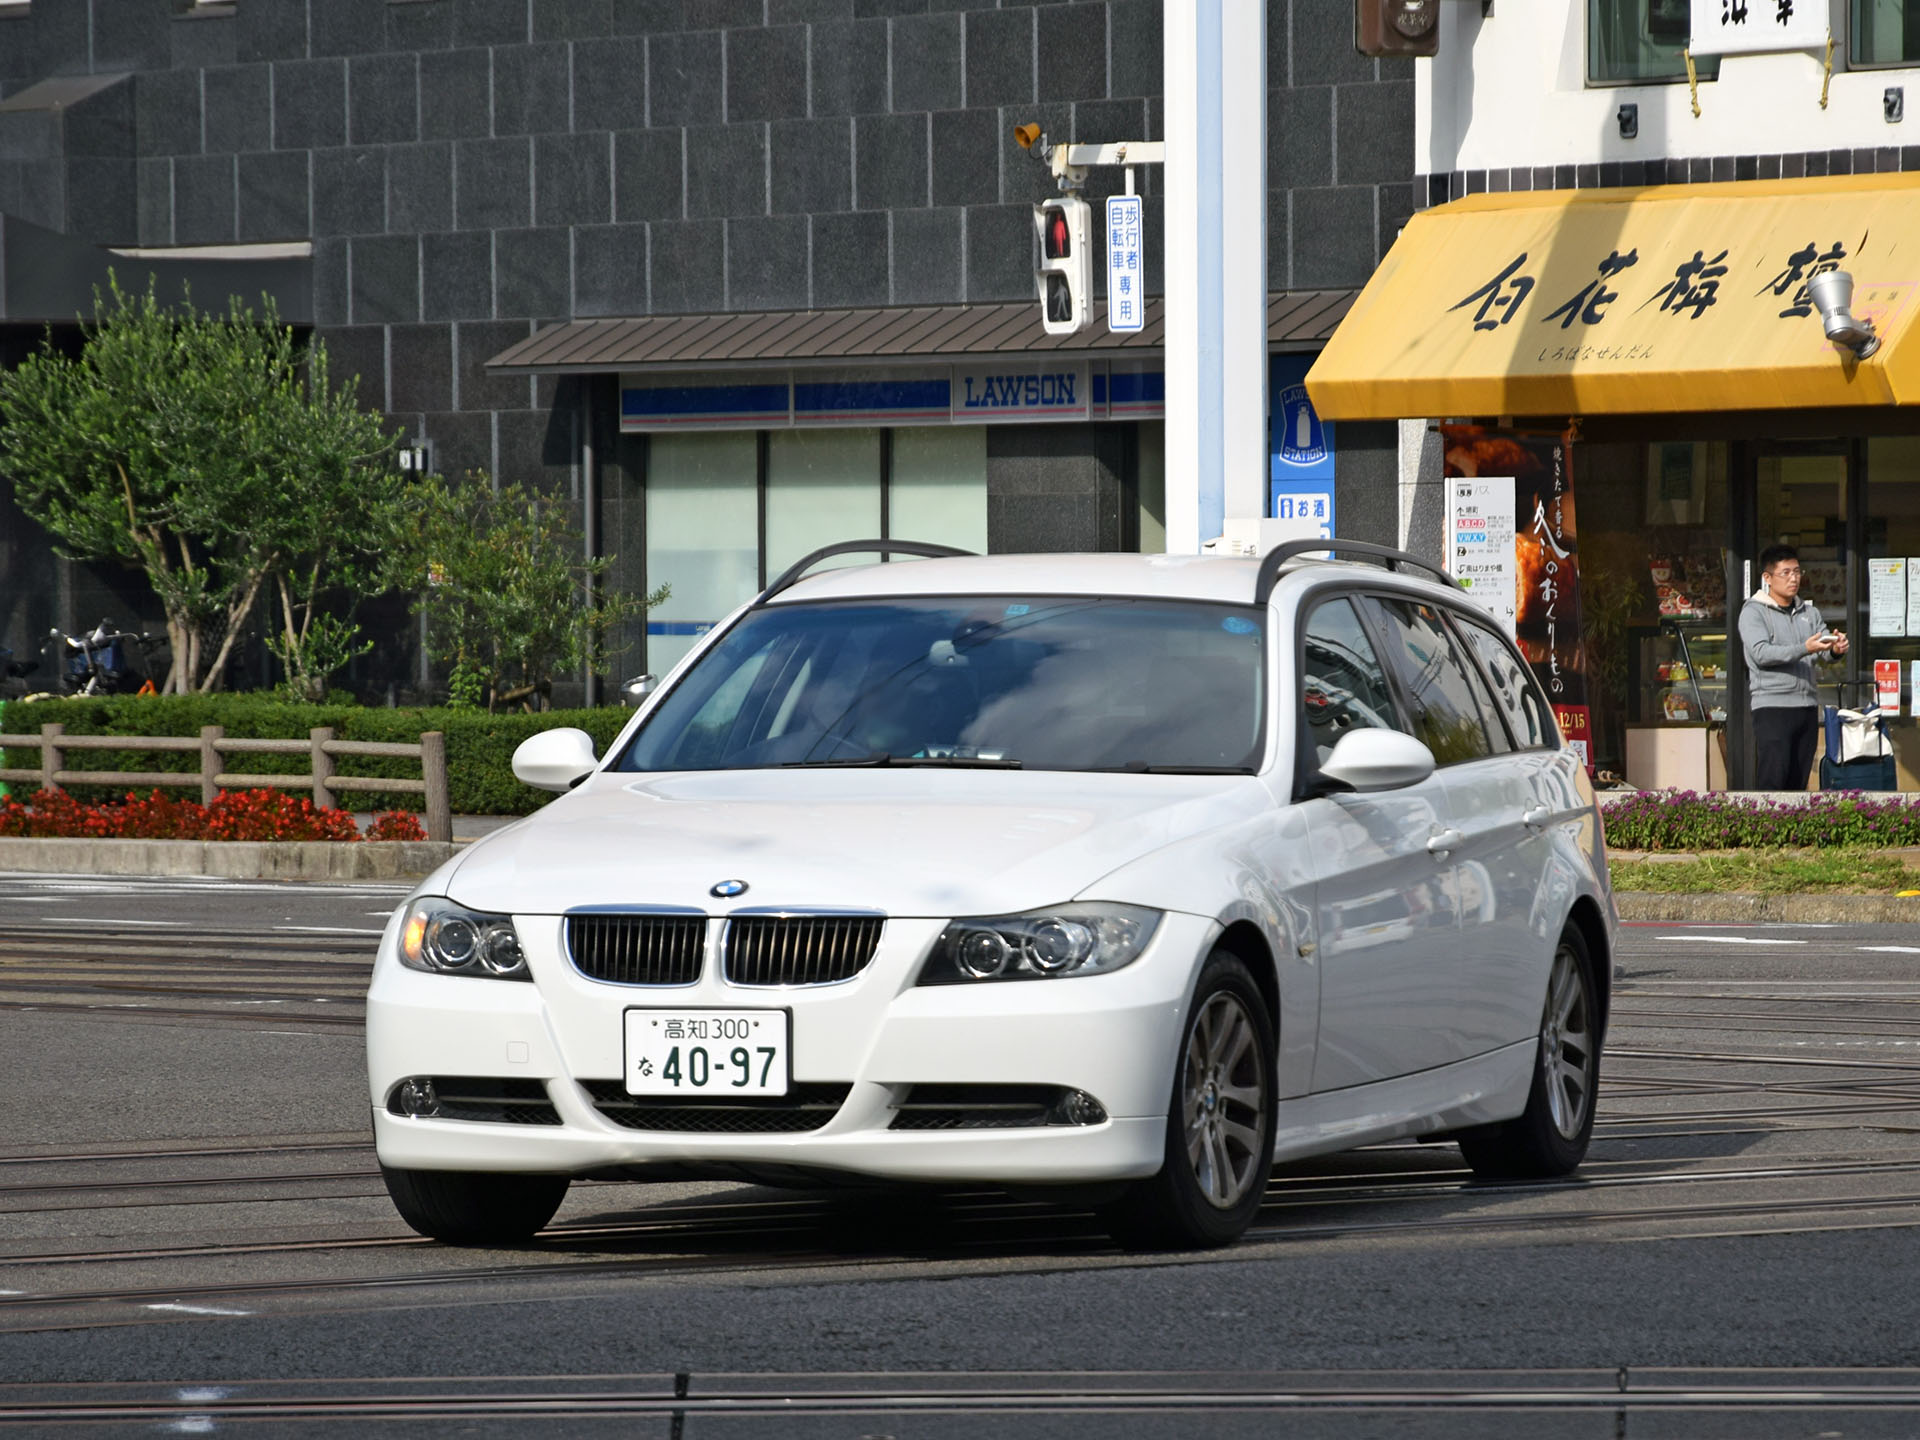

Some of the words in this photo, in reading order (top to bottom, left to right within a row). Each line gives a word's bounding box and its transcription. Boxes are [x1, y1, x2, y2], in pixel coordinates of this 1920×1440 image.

[1111, 206, 1124, 269] 自転車
[1125, 206, 1138, 269] 歩行者
[1120, 276, 1131, 320] 専用
[965, 373, 1076, 407] LAWSON
[1283, 446, 1324, 462] STATION
[1474, 485, 1490, 496] バス
[1298, 500, 1325, 517] お酒
[1560, 712, 1585, 729] 12/15
[638, 1056, 653, 1077] な
[663, 1046, 776, 1087] 40-97
